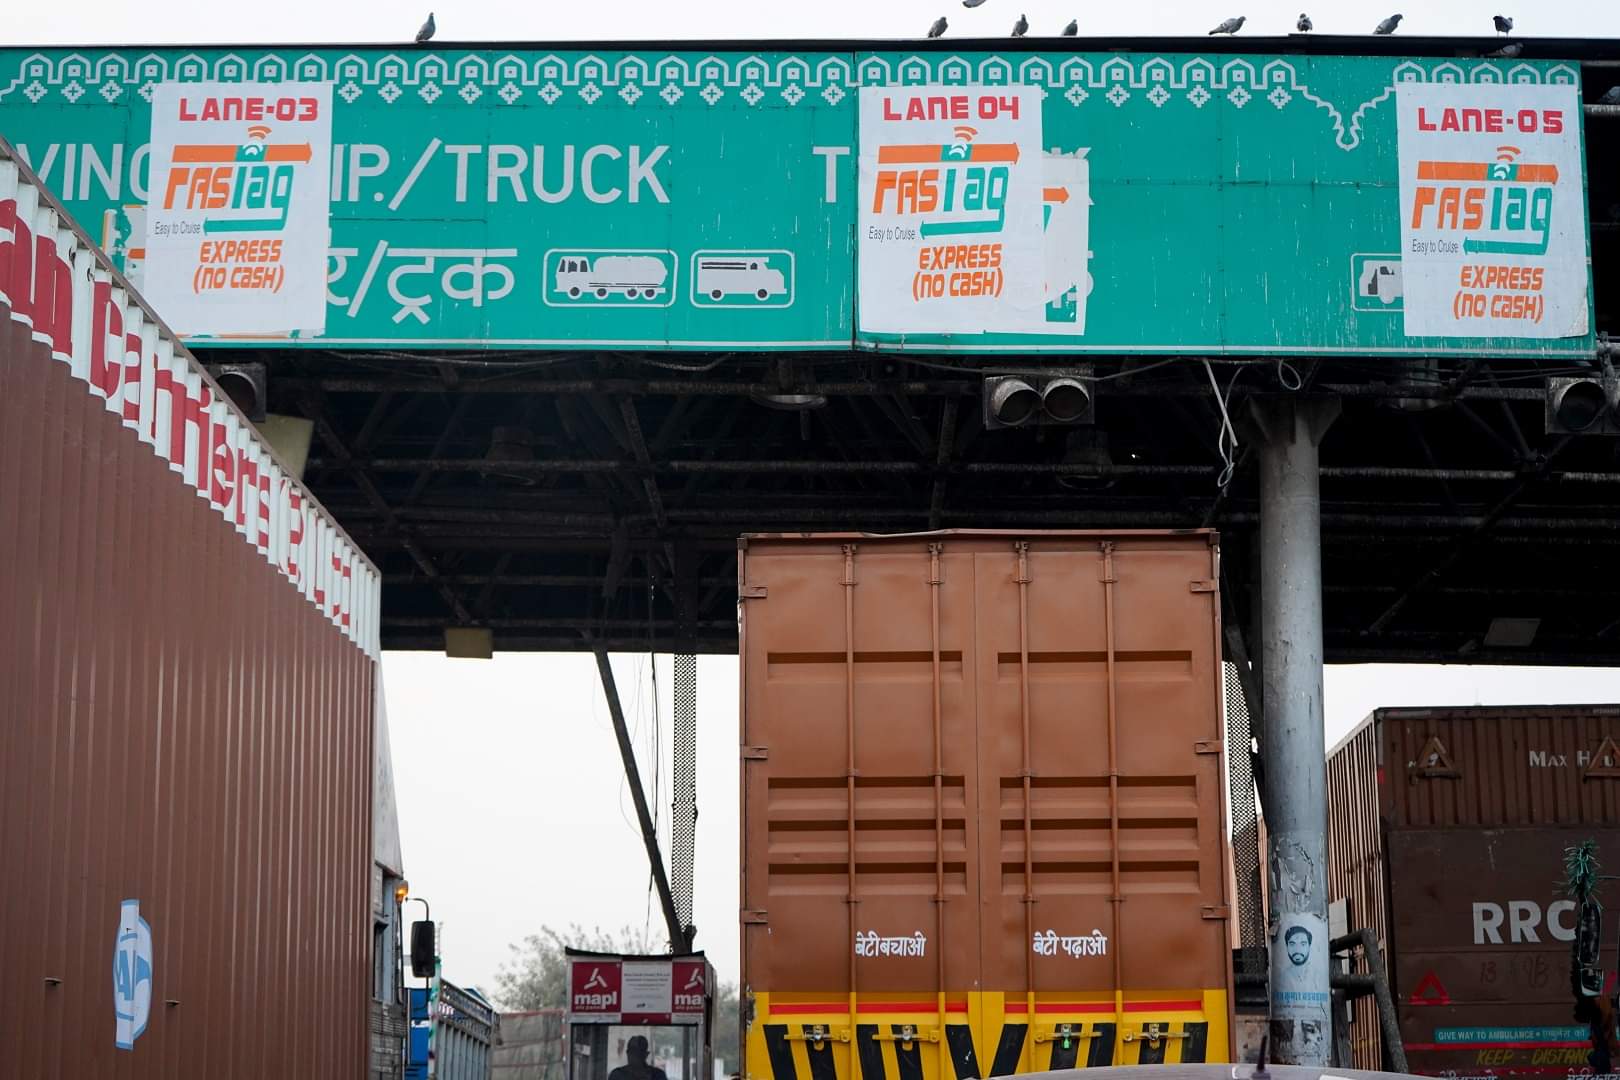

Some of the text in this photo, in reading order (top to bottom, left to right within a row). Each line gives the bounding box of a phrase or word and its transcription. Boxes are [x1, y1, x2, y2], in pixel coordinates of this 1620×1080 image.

[884, 96, 1019, 120] LANE 04
[154, 221, 201, 237] Easy to Cruise
[868, 226, 915, 243] Easy to Cruise
[200, 240, 283, 263] EXPRESS
[919, 244, 1003, 271] EXPRESS
[1412, 239, 1460, 255] Easy to Cruise
[1460, 265, 1544, 291] EXPRESS
[855, 930, 927, 957] बेटी बचाओ
[1033, 929, 1059, 956] बेटी
[1438, 1031, 1456, 1040] GIVE
[1457, 1031, 1474, 1040] WAY
[1476, 1031, 1486, 1040] TO
[1488, 1030, 1534, 1040] AMBULANCE
[1476, 1049, 1514, 1065] KEEP
